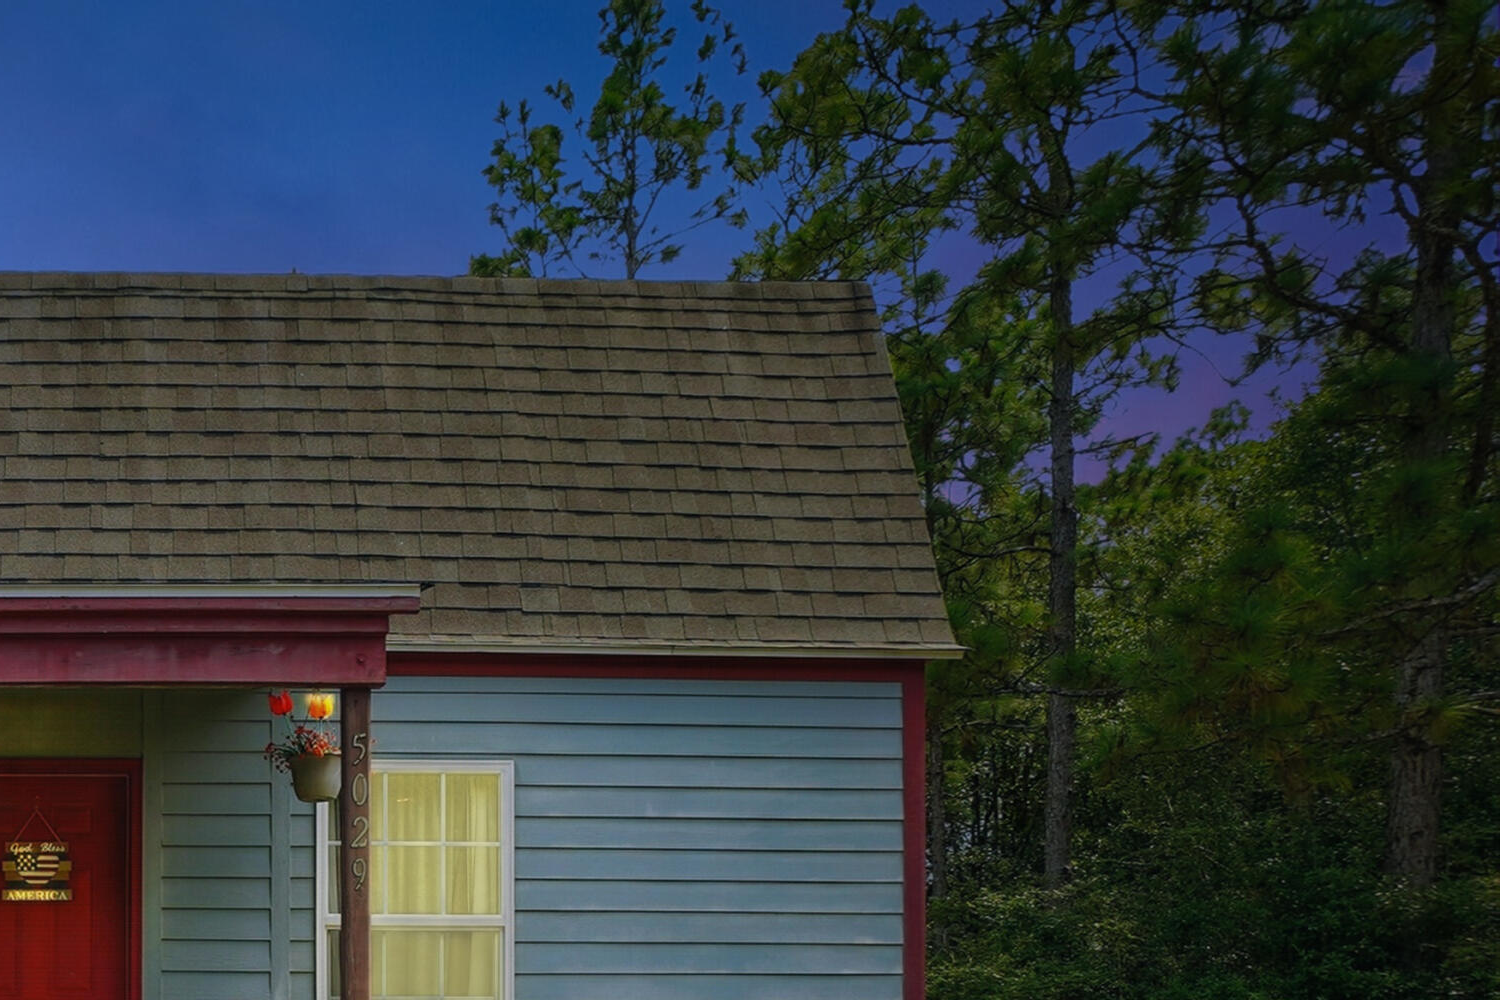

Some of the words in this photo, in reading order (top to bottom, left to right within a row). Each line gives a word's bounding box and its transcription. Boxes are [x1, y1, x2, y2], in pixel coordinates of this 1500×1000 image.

[351, 733, 369, 891] 5029
[10, 842, 33, 855] God
[40, 842, 65, 852] Bless
[7, 891, 68, 901] AMERICA
